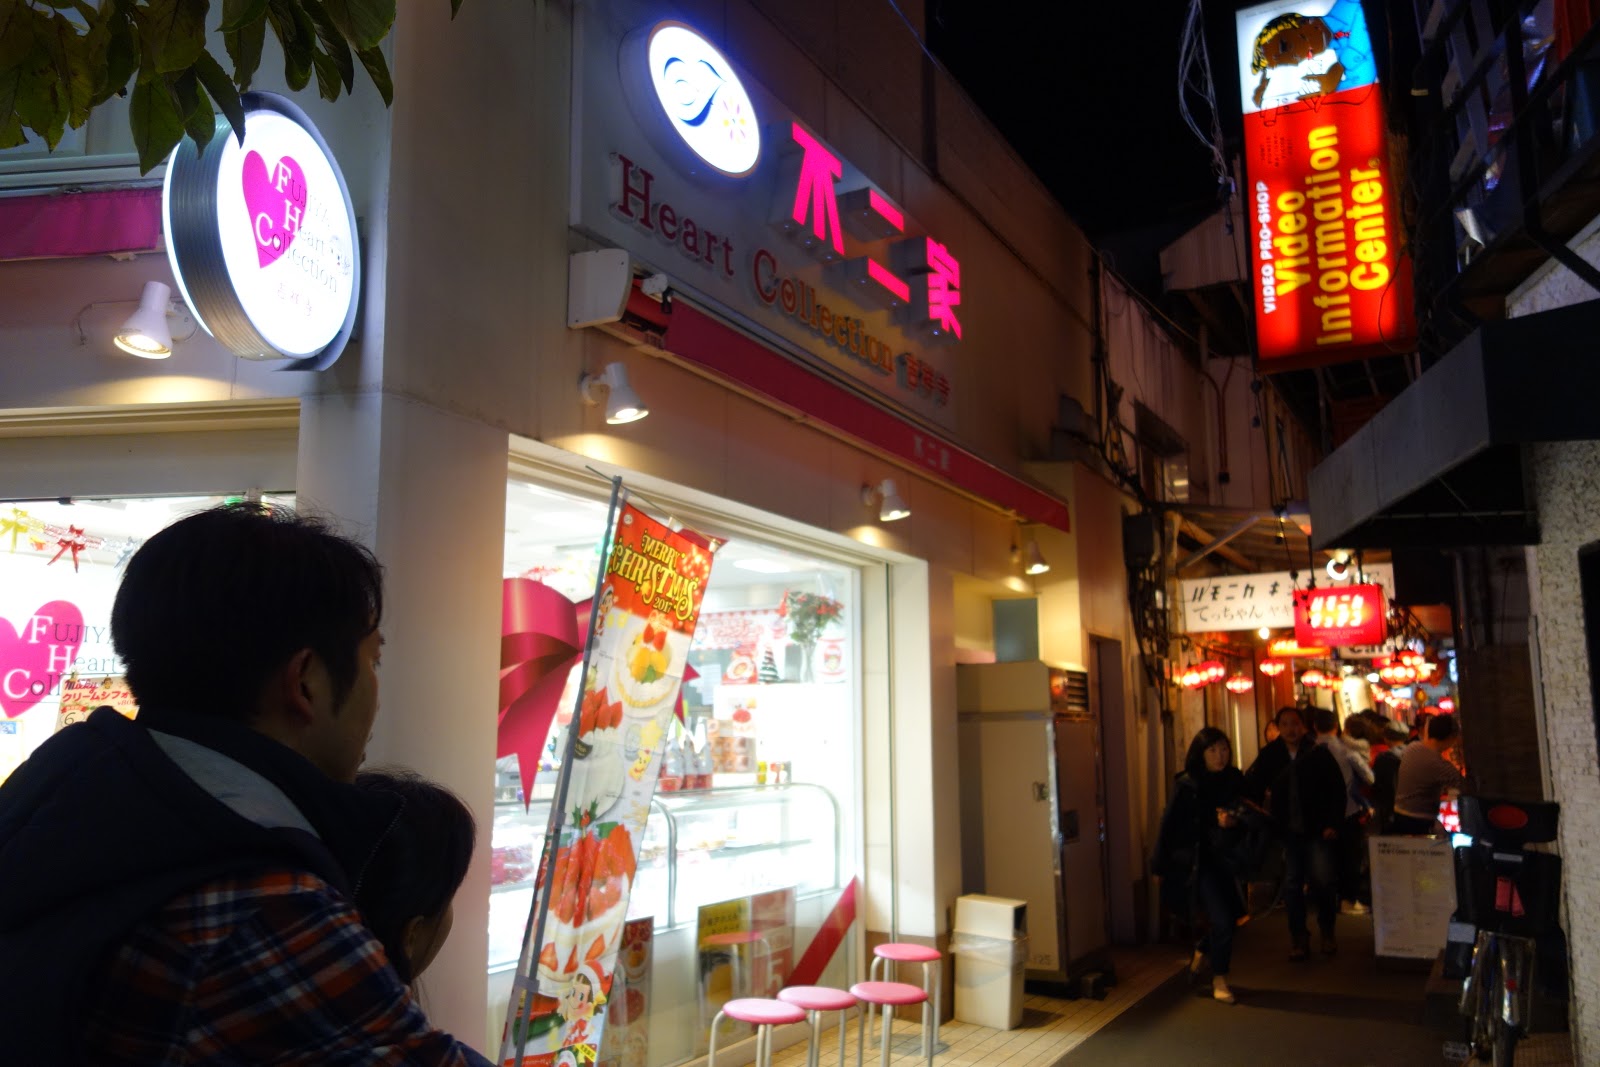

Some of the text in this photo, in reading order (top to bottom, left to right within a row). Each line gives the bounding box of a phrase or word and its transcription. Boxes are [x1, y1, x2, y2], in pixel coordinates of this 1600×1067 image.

[255, 212, 338, 293] Collection
[617, 153, 895, 378] Heart Collection
[792, 122, 961, 340] 不二家
[1256, 180, 1277, 314] VIDEO PRO-SHOP
[1273, 190, 1311, 297] Video
[1305, 124, 1352, 345] Information
[1345, 168, 1390, 291] Center
[611, 544, 698, 620] CHRISTMAS
[642, 534, 681, 569] MERRY
[653, 596, 673, 613] 2017
[3, 668, 60, 699] Coll
[46, 643, 118, 674] Heart
[62, 690, 131, 703] クリームシフォ
